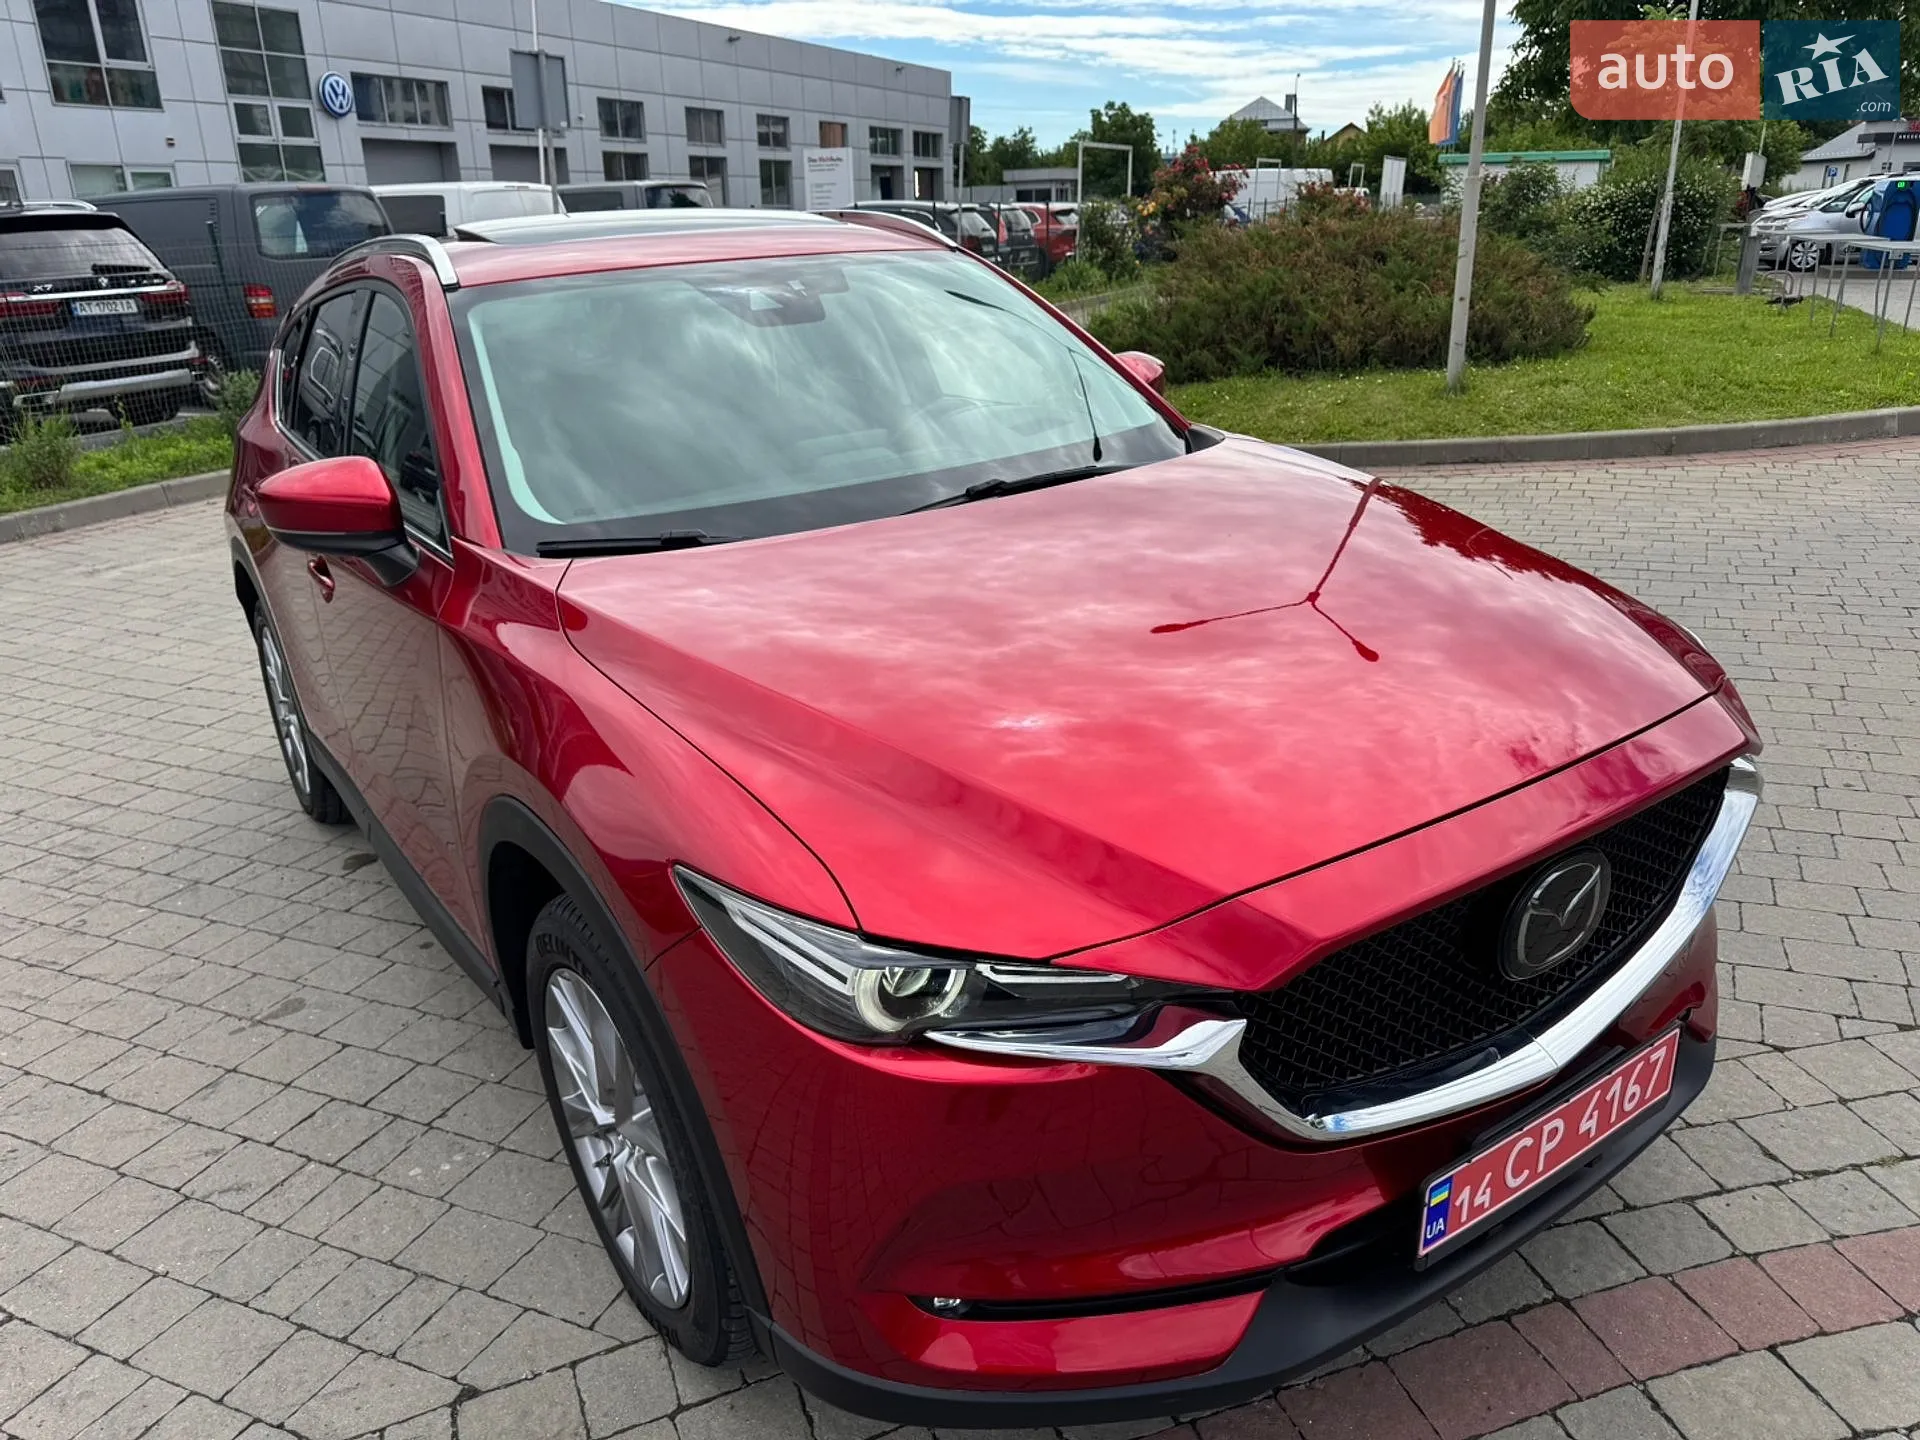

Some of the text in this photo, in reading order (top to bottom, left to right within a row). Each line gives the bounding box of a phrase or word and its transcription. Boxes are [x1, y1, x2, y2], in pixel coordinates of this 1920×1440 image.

[33, 284, 53, 292] X7
[1455, 1046, 1667, 1223] 14 CP 4167
[1425, 1217, 1445, 1239] UA
